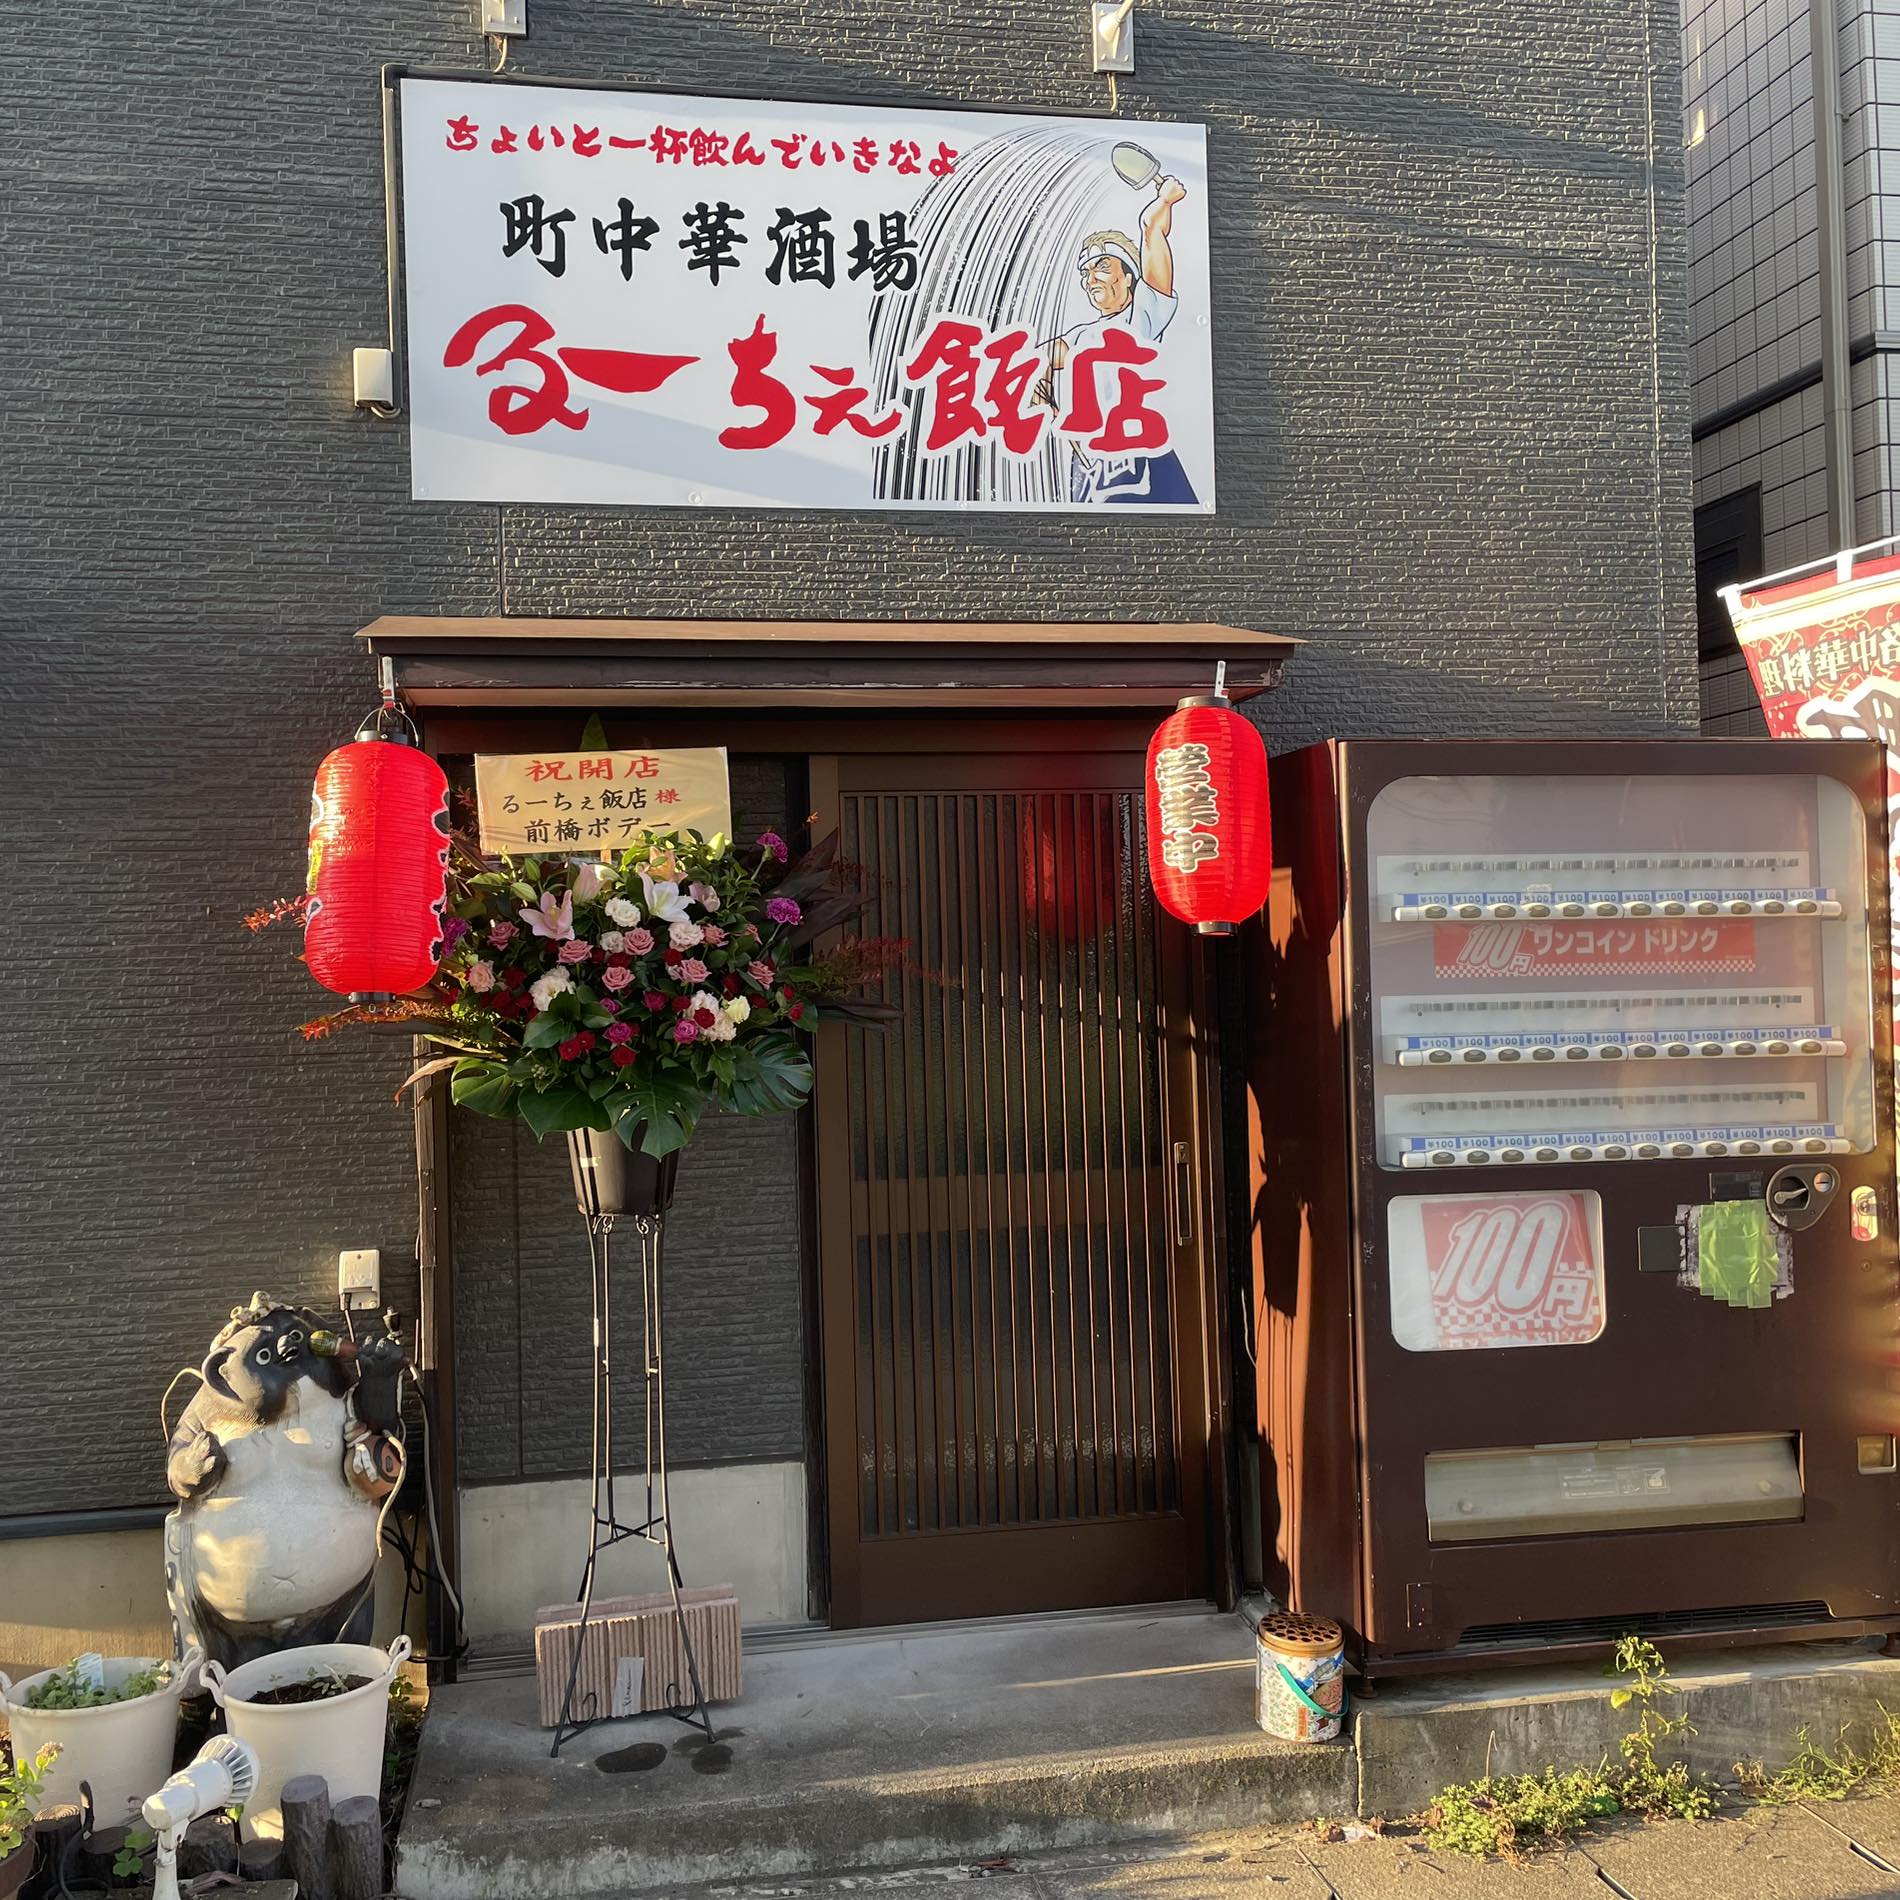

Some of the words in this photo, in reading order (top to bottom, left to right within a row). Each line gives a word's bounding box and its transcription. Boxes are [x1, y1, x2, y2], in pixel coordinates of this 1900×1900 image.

[446, 115, 958, 177] ちょいと一杯飲んでいきなよ
[500, 194, 919, 292] 町中華酒場
[524, 756, 661, 783] 祝開店
[524, 816, 671, 844] 前橋ボデー
[1457, 923, 1534, 975] 100円
[1432, 1202, 1594, 1320] 100円
